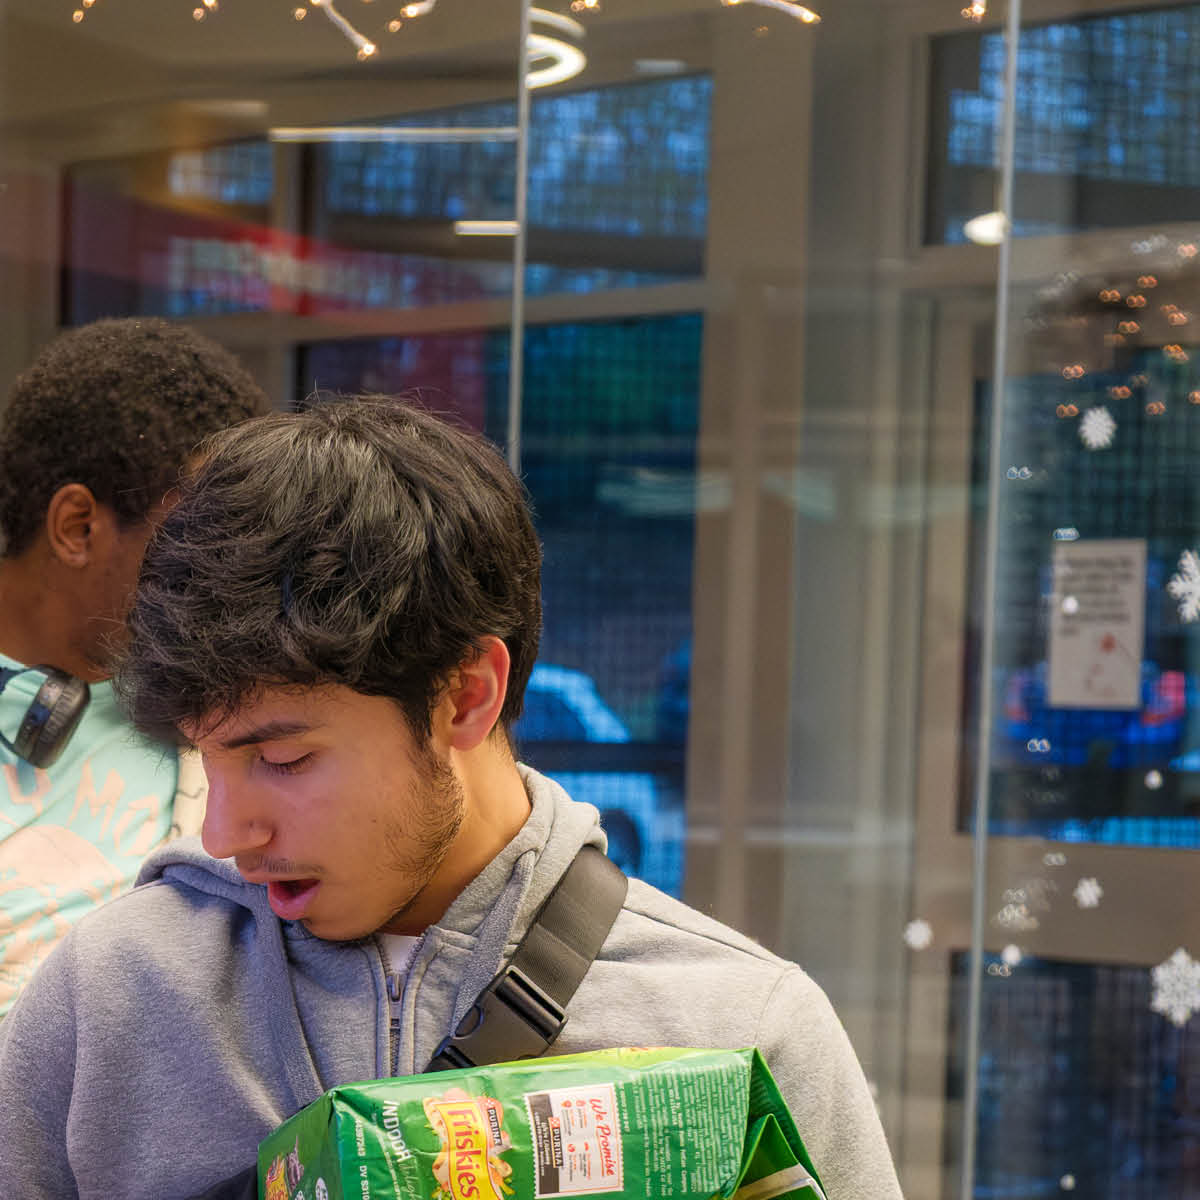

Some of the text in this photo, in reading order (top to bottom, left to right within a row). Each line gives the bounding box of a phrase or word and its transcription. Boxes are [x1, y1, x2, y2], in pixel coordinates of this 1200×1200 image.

[382, 1100, 412, 1163] INDOOR
[447, 1108, 482, 1200] Friskies
[487, 1108, 502, 1146] PURINA
[553, 1128, 564, 1167] PURINA
[589, 1098, 617, 1177] We Promise
